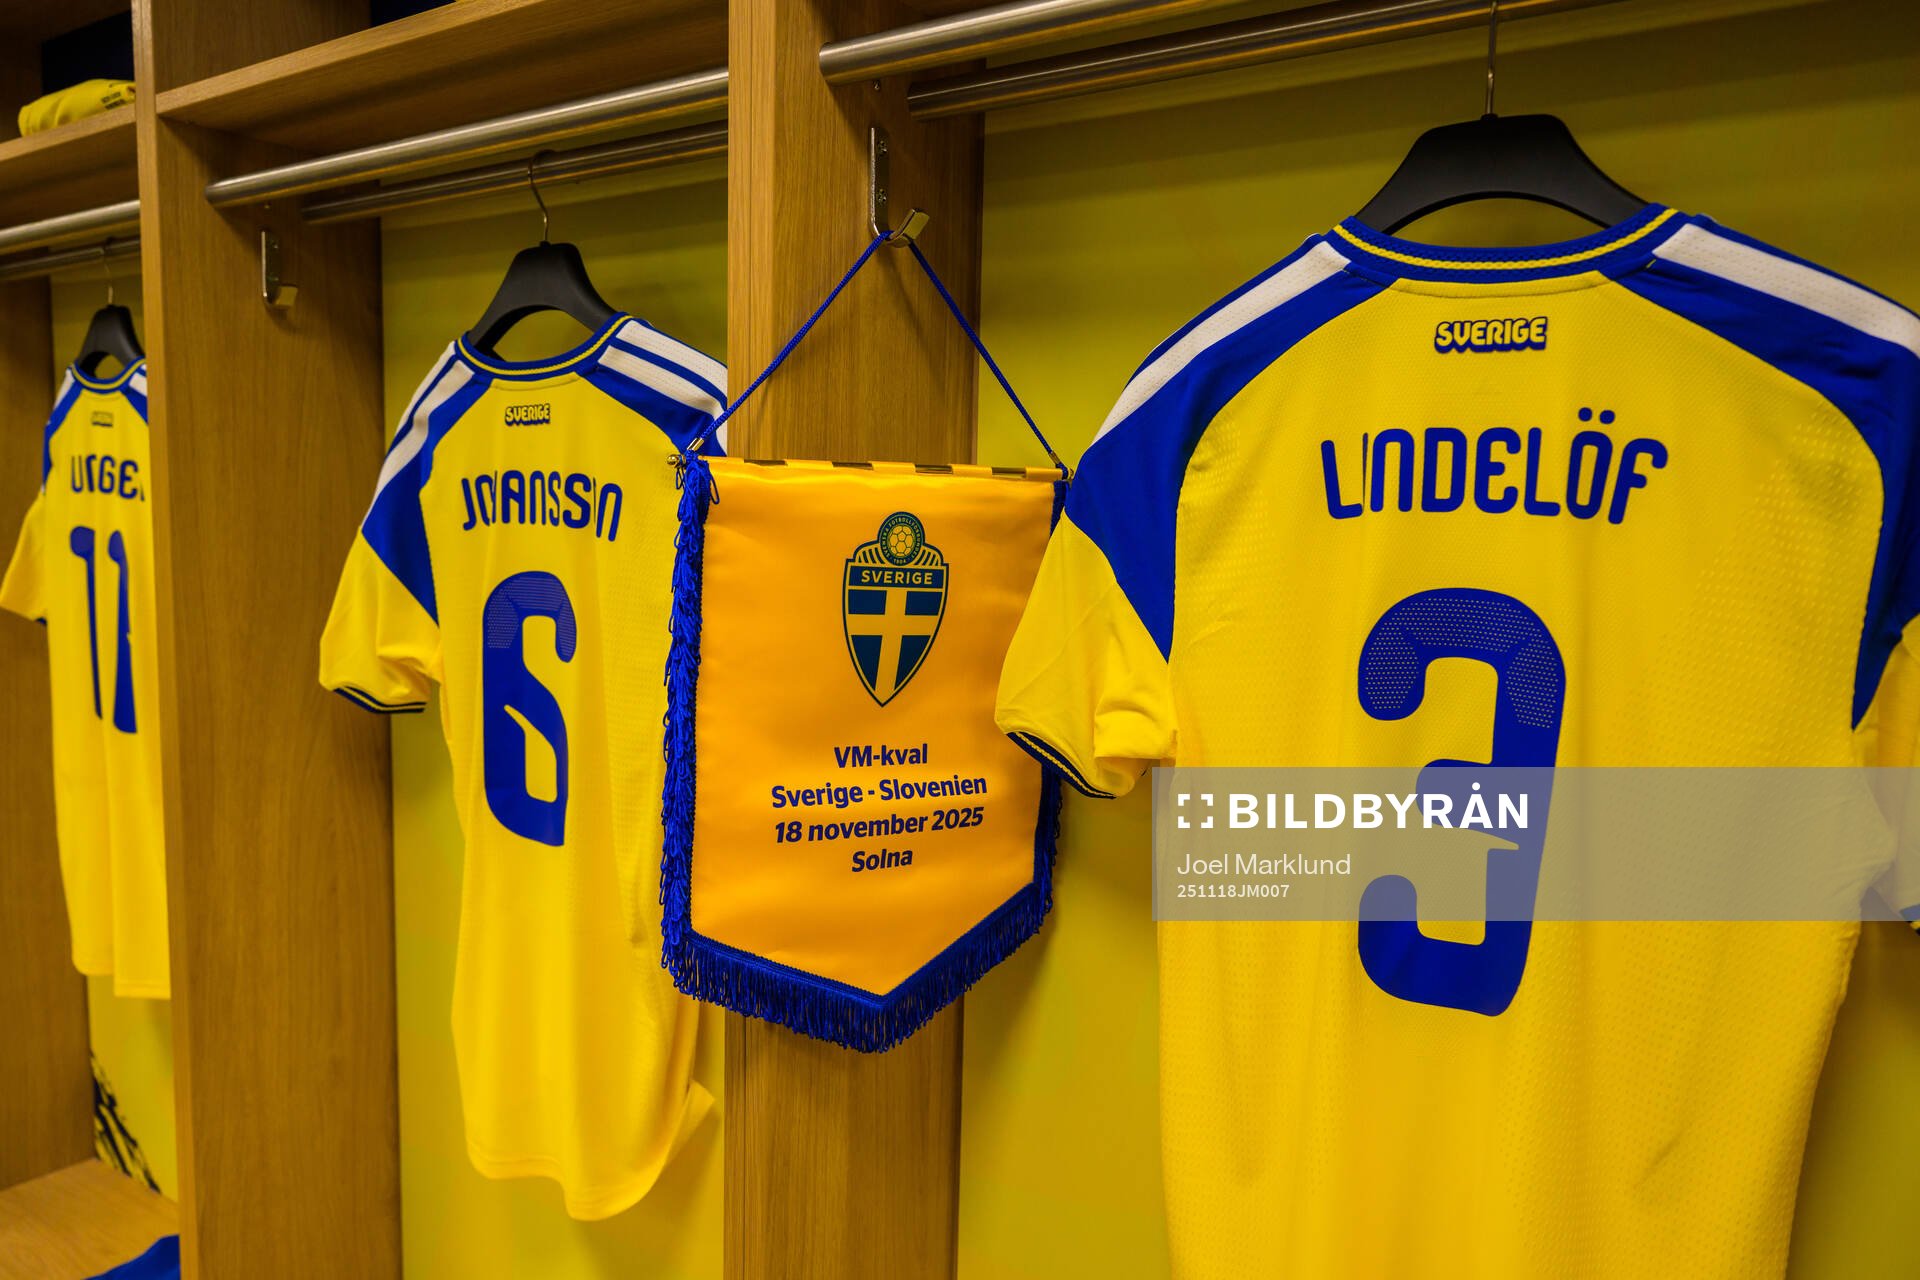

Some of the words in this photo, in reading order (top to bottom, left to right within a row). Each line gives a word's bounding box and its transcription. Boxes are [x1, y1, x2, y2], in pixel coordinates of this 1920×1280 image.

[1434, 316, 1548, 354] SVERIGE
[504, 403, 551, 426] SVERIGE
[1320, 406, 1669, 525] LNDELÖF
[861, 569, 933, 586] SVERIGE
[70, 525, 138, 734] 11
[482, 570, 577, 847] 6
[834, 743, 928, 769] VM-kval
[771, 782, 863, 809] Sverige
[878, 774, 988, 801] Slovenien
[1357, 587, 1567, 1017] 3
[775, 821, 803, 844] 18
[808, 813, 928, 842] november
[931, 806, 984, 832] 2025
[851, 848, 913, 873] Solna
